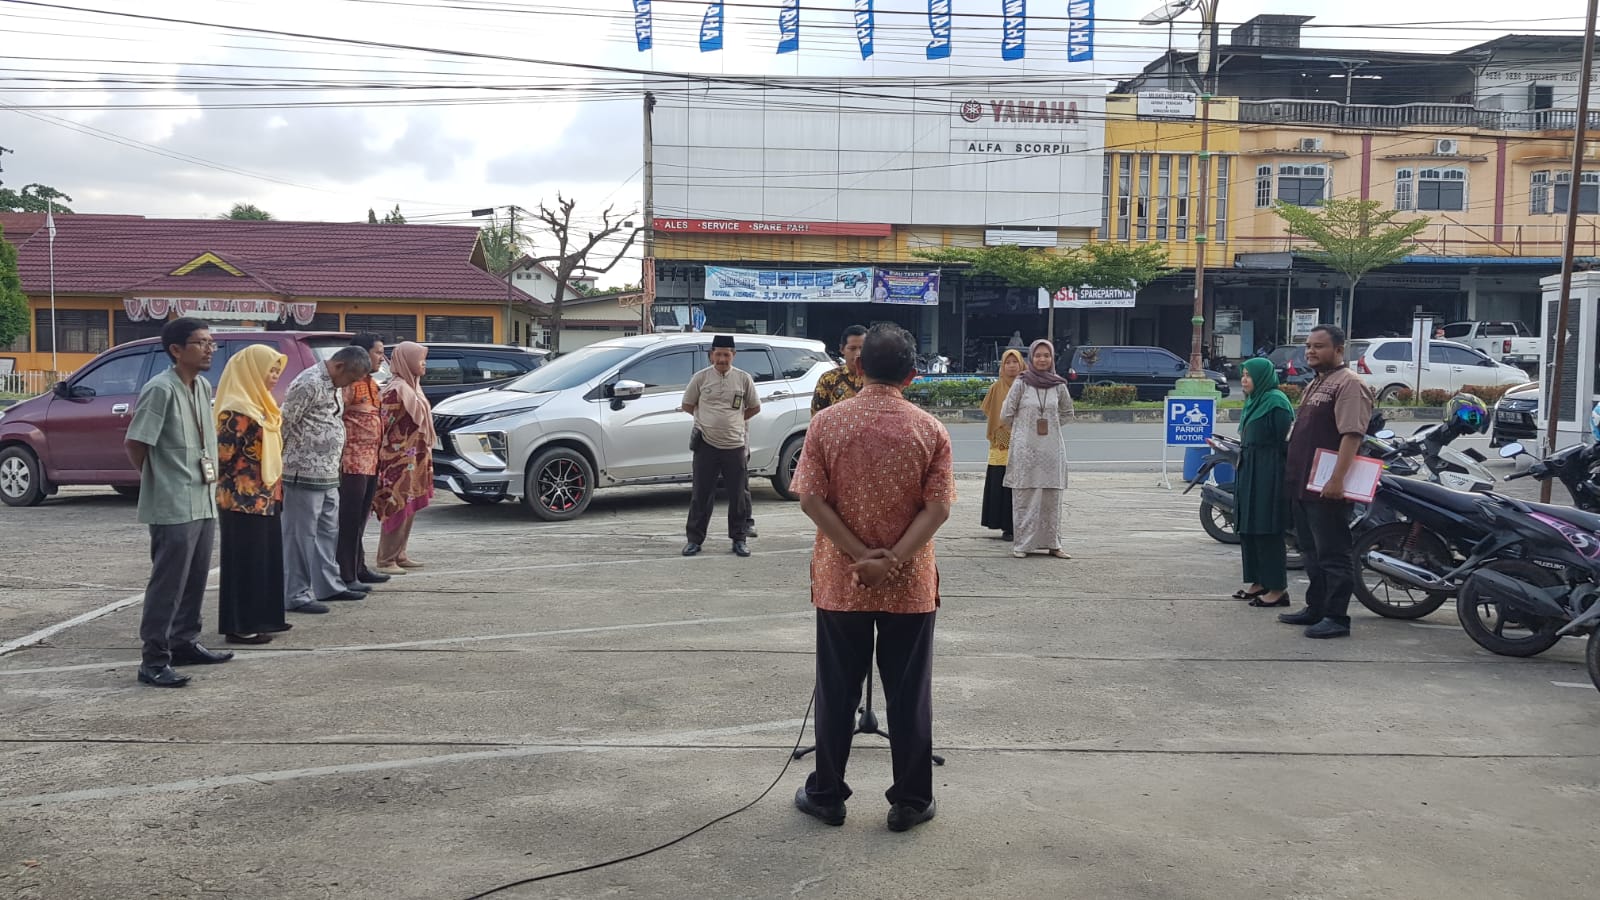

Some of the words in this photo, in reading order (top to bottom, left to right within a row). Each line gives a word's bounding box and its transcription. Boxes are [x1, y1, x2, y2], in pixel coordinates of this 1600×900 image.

[990, 100, 1079, 124] YAMAHA
[968, 143, 1002, 153] ALFA
[1015, 143, 1070, 154] SCORPII
[701, 222, 740, 230] SERVICE
[752, 222, 782, 231] SPARE
[1080, 289, 1131, 299] SPAREPARTNYA
[1171, 403, 1186, 421] P
